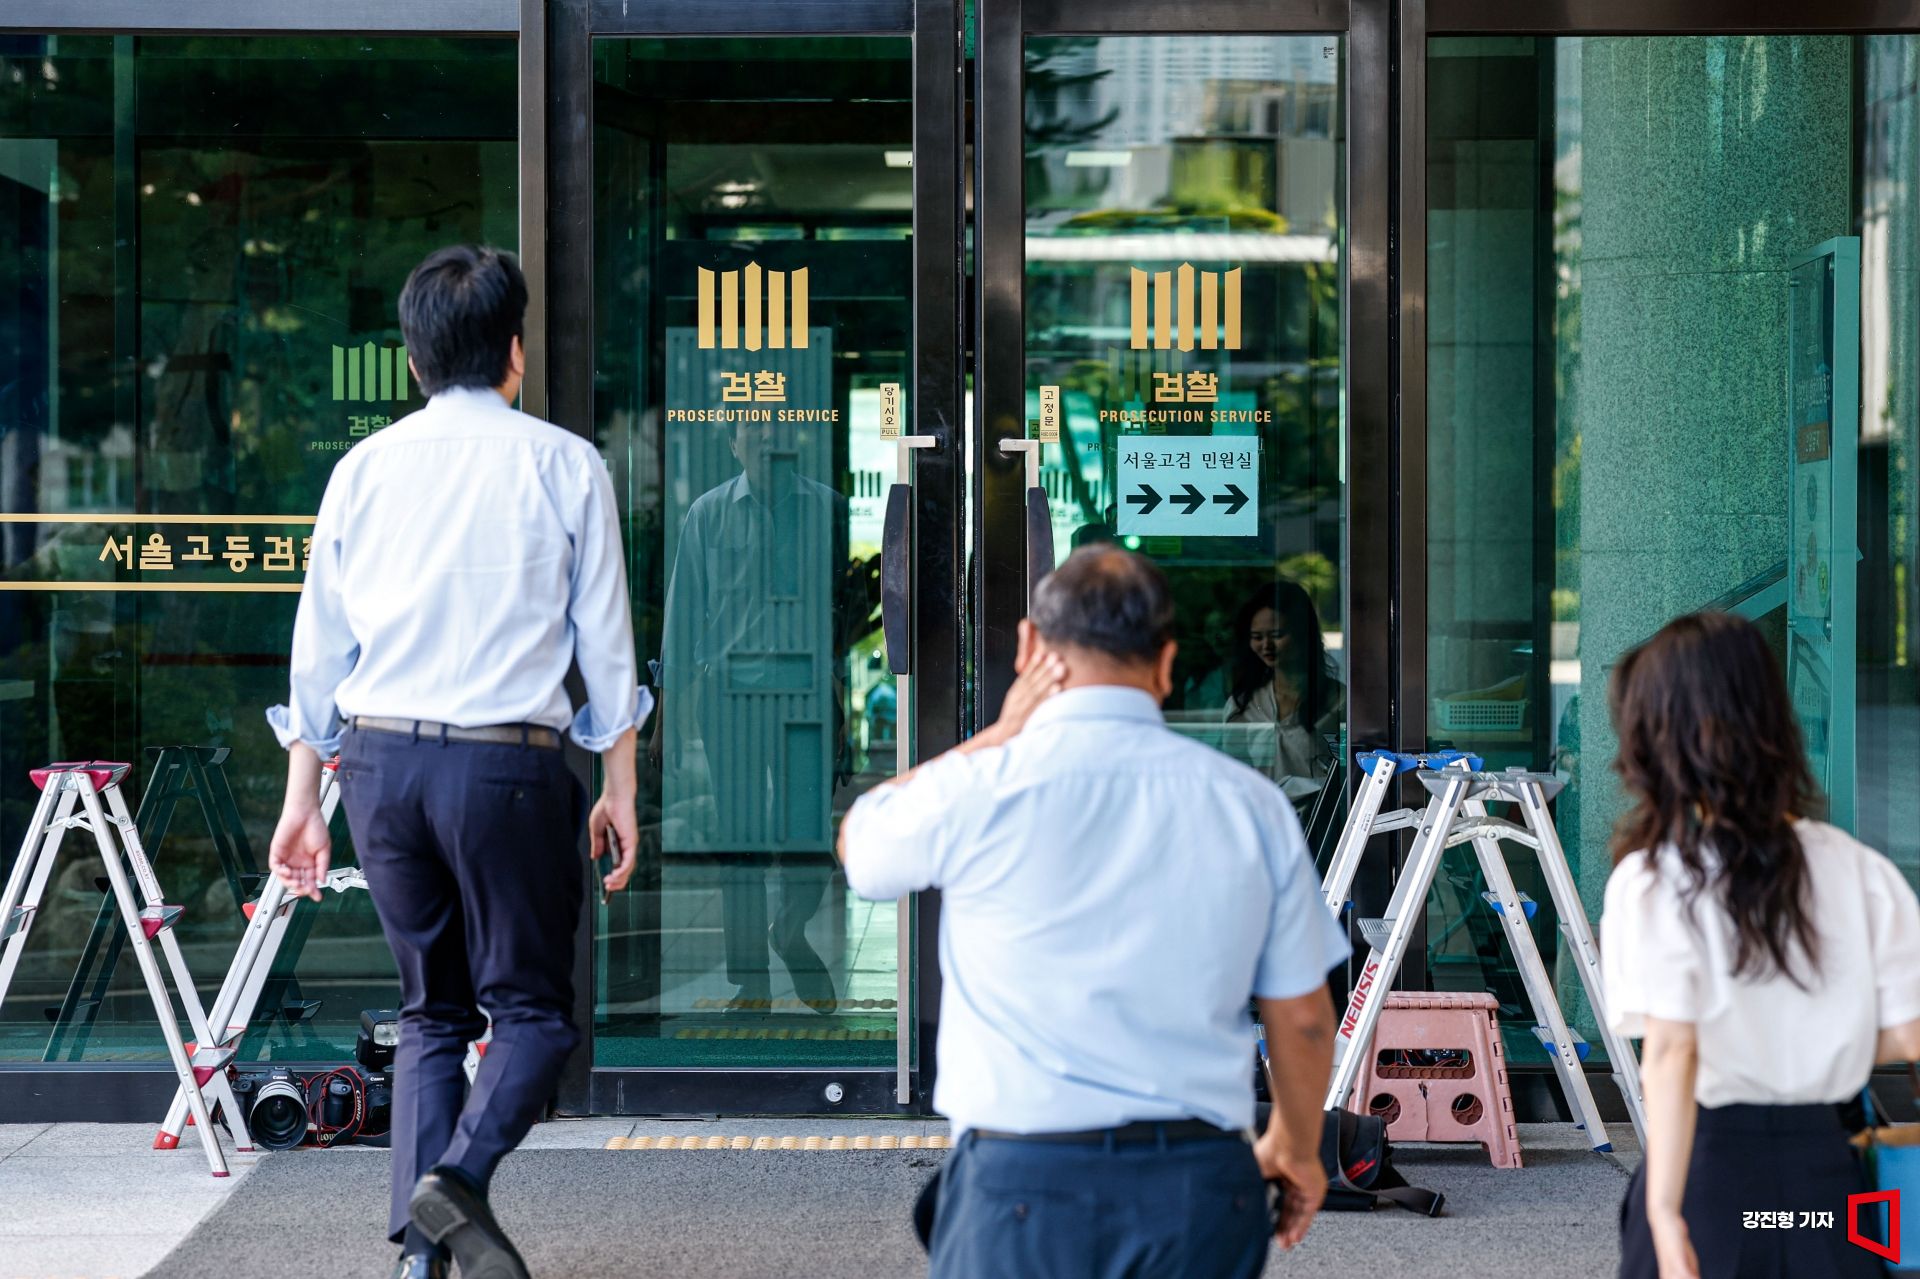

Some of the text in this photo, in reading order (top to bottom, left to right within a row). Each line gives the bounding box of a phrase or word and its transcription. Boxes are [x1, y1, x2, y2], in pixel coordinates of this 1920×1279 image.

[720, 370, 786, 402] 검찰
[1153, 370, 1218, 403] 검찰
[668, 409, 839, 422] PROSECUTION SERVICE
[884, 387, 895, 425] 당기시오
[1044, 390, 1054, 427] 고정문
[1100, 410, 1271, 423] PROSECUTION SERVICE
[1123, 451, 1251, 470] 서울고검 민원실
[99, 533, 314, 573] 서울고등검
[1340, 959, 1379, 1039] NEWSIS
